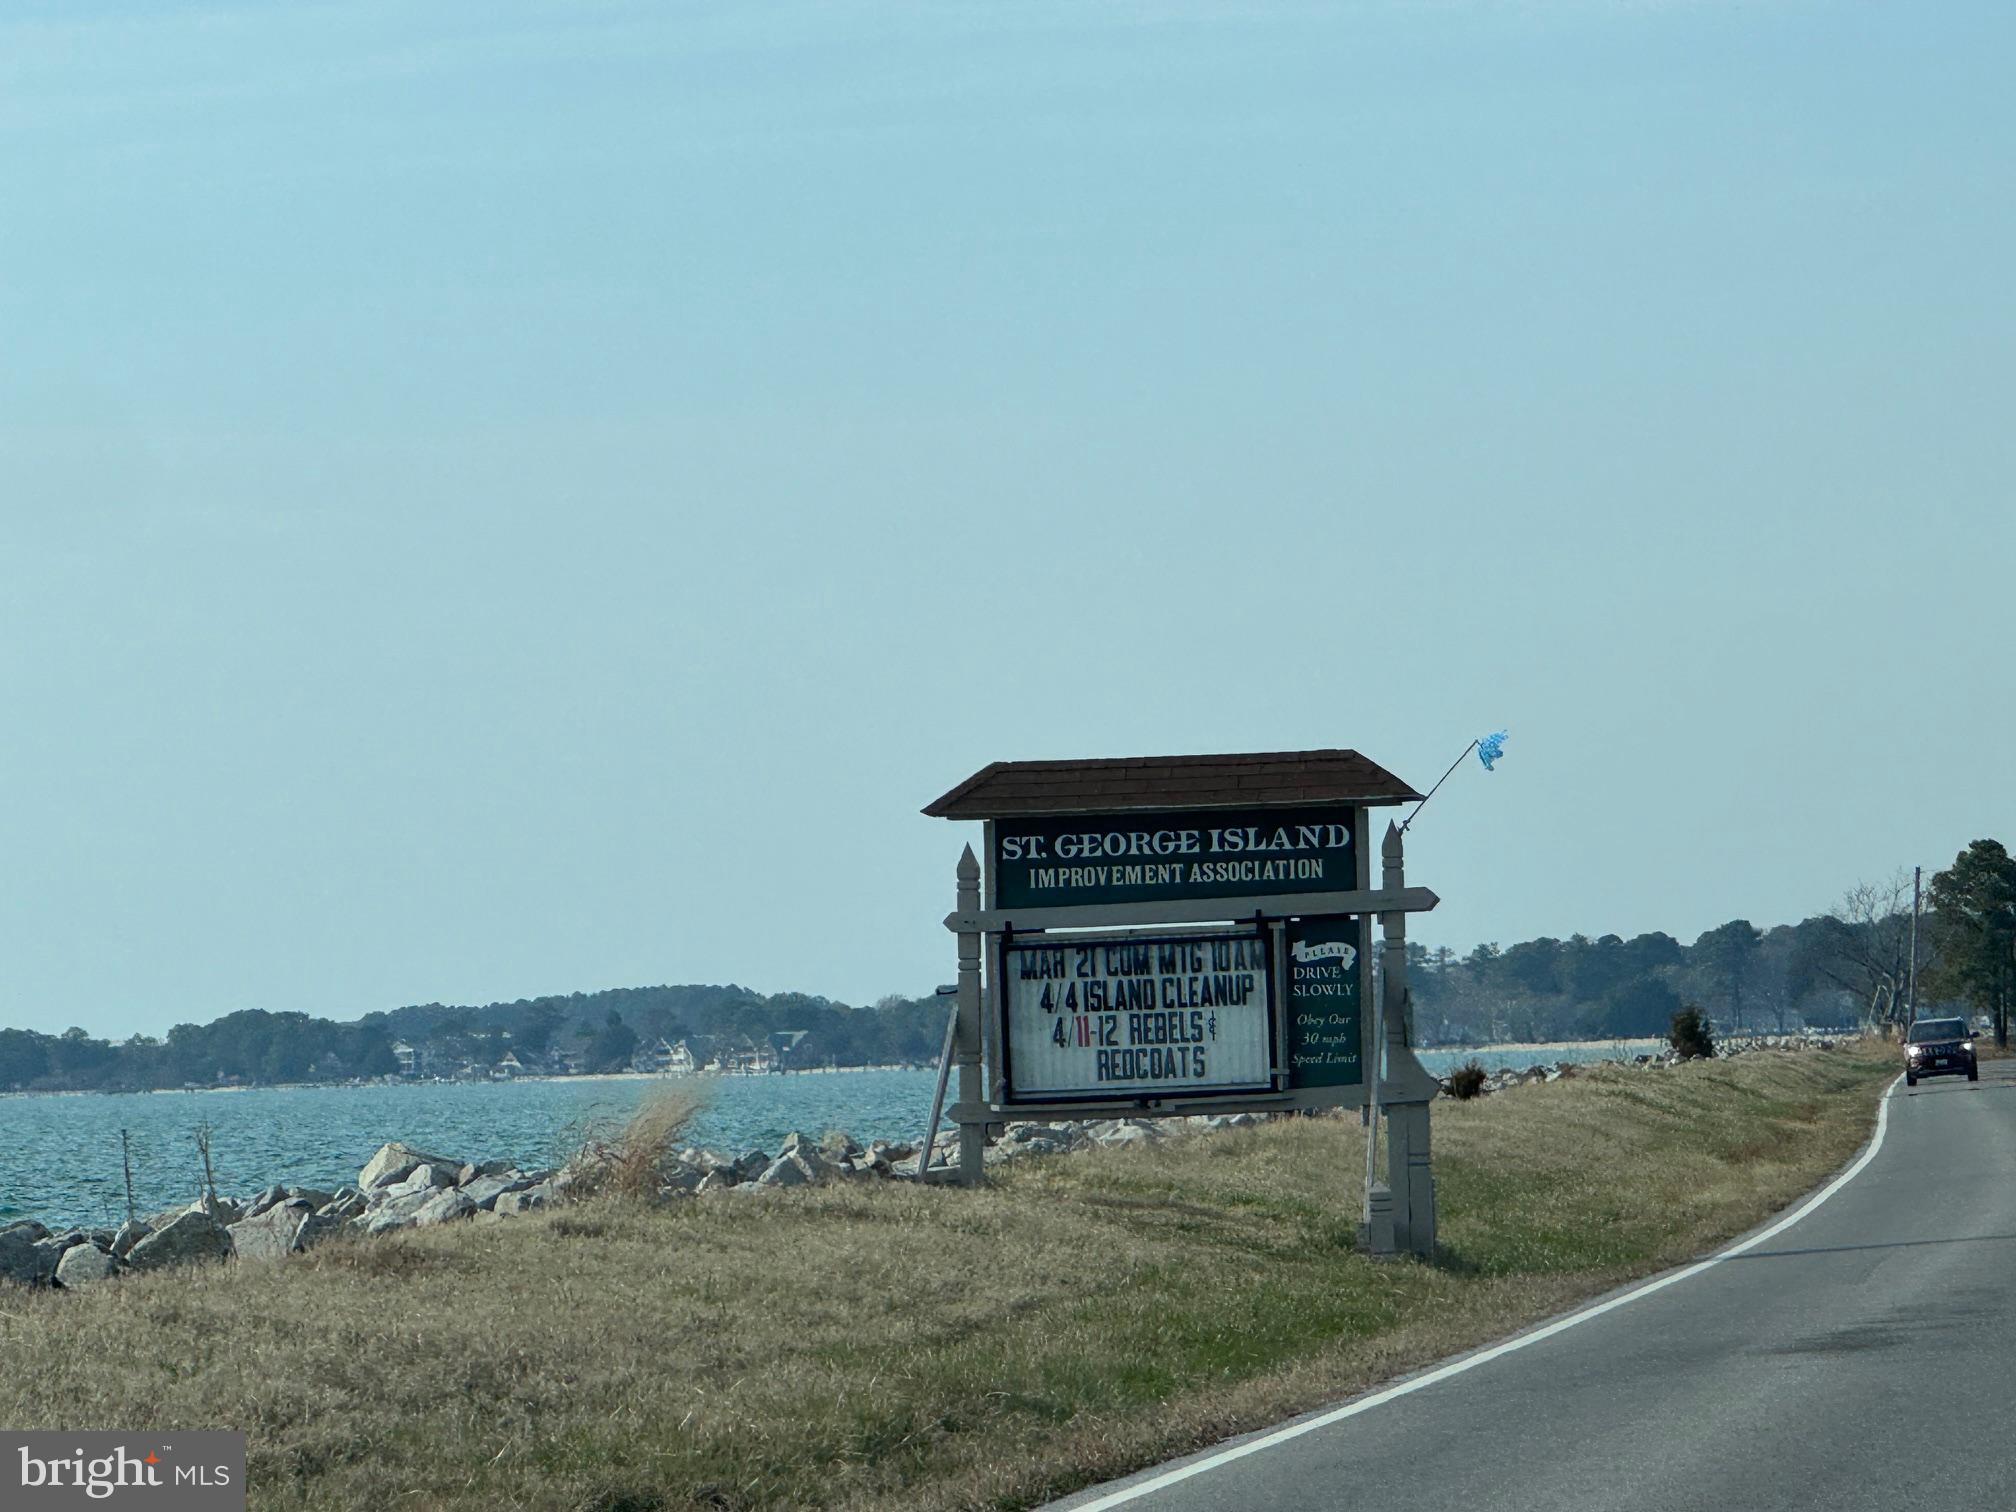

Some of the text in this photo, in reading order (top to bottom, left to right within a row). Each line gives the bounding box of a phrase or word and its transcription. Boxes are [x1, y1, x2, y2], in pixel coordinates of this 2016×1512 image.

[1002, 824, 1350, 859] ST. GEORGE ISLAND
[1030, 859, 1324, 888] IMPROVEMENT ASSOCIATION
[1106, 945, 1151, 976] COM
[1304, 946, 1350, 959] PLEASE
[1293, 966, 1341, 980] DRIVE
[1040, 975, 1254, 1013] 4/4 ISLAND CLEANUP
[1293, 984, 1354, 997] SLOWLY
[1130, 1011, 1203, 1045] REBELS
[1098, 1046, 1205, 1081] REDCOATS
